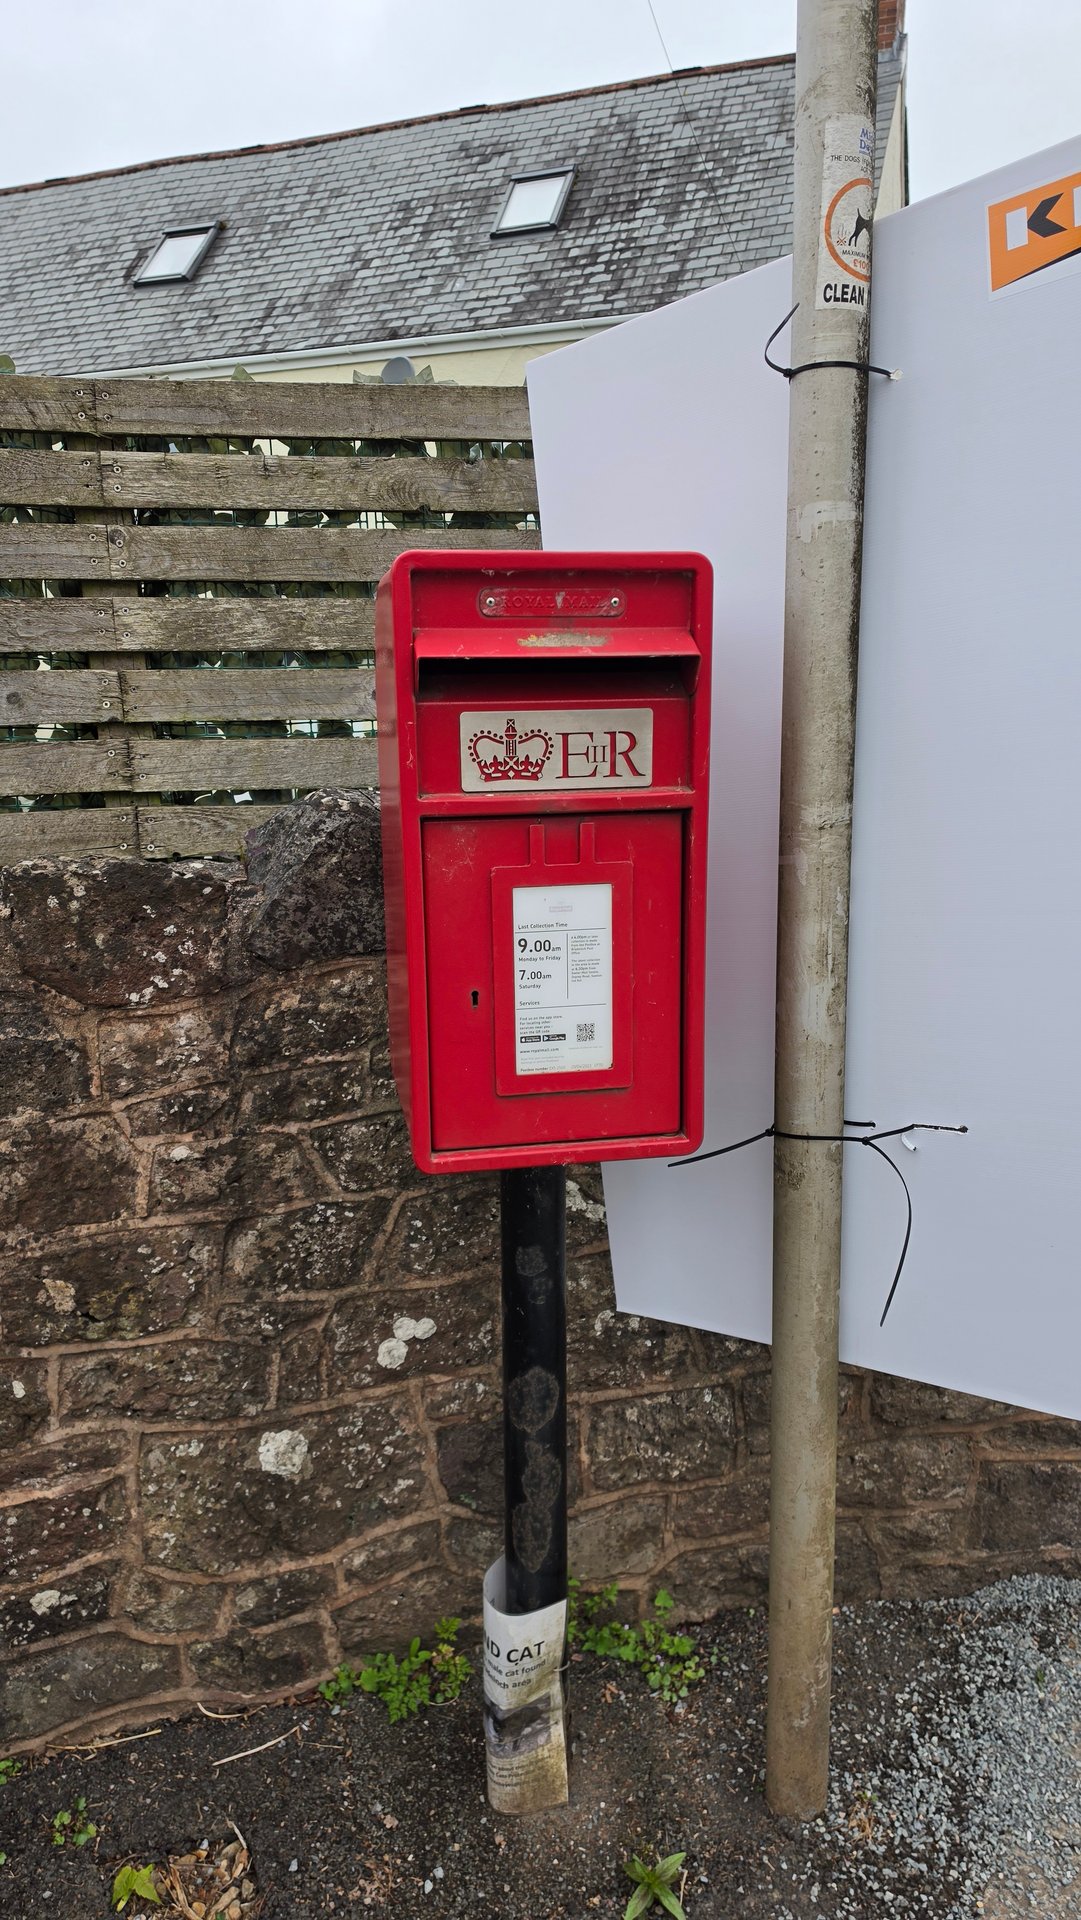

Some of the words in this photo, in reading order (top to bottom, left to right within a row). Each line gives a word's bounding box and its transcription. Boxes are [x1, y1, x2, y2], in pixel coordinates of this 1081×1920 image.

[844, 155, 860, 163] DOGS
[823, 283, 864, 305] CLEAN
[502, 596, 555, 608] ROYAL
[565, 595, 605, 608] MAIL
[506, 1640, 545, 1663] CAT
[521, 1659, 546, 1674] found
[512, 1678, 532, 1688] area
